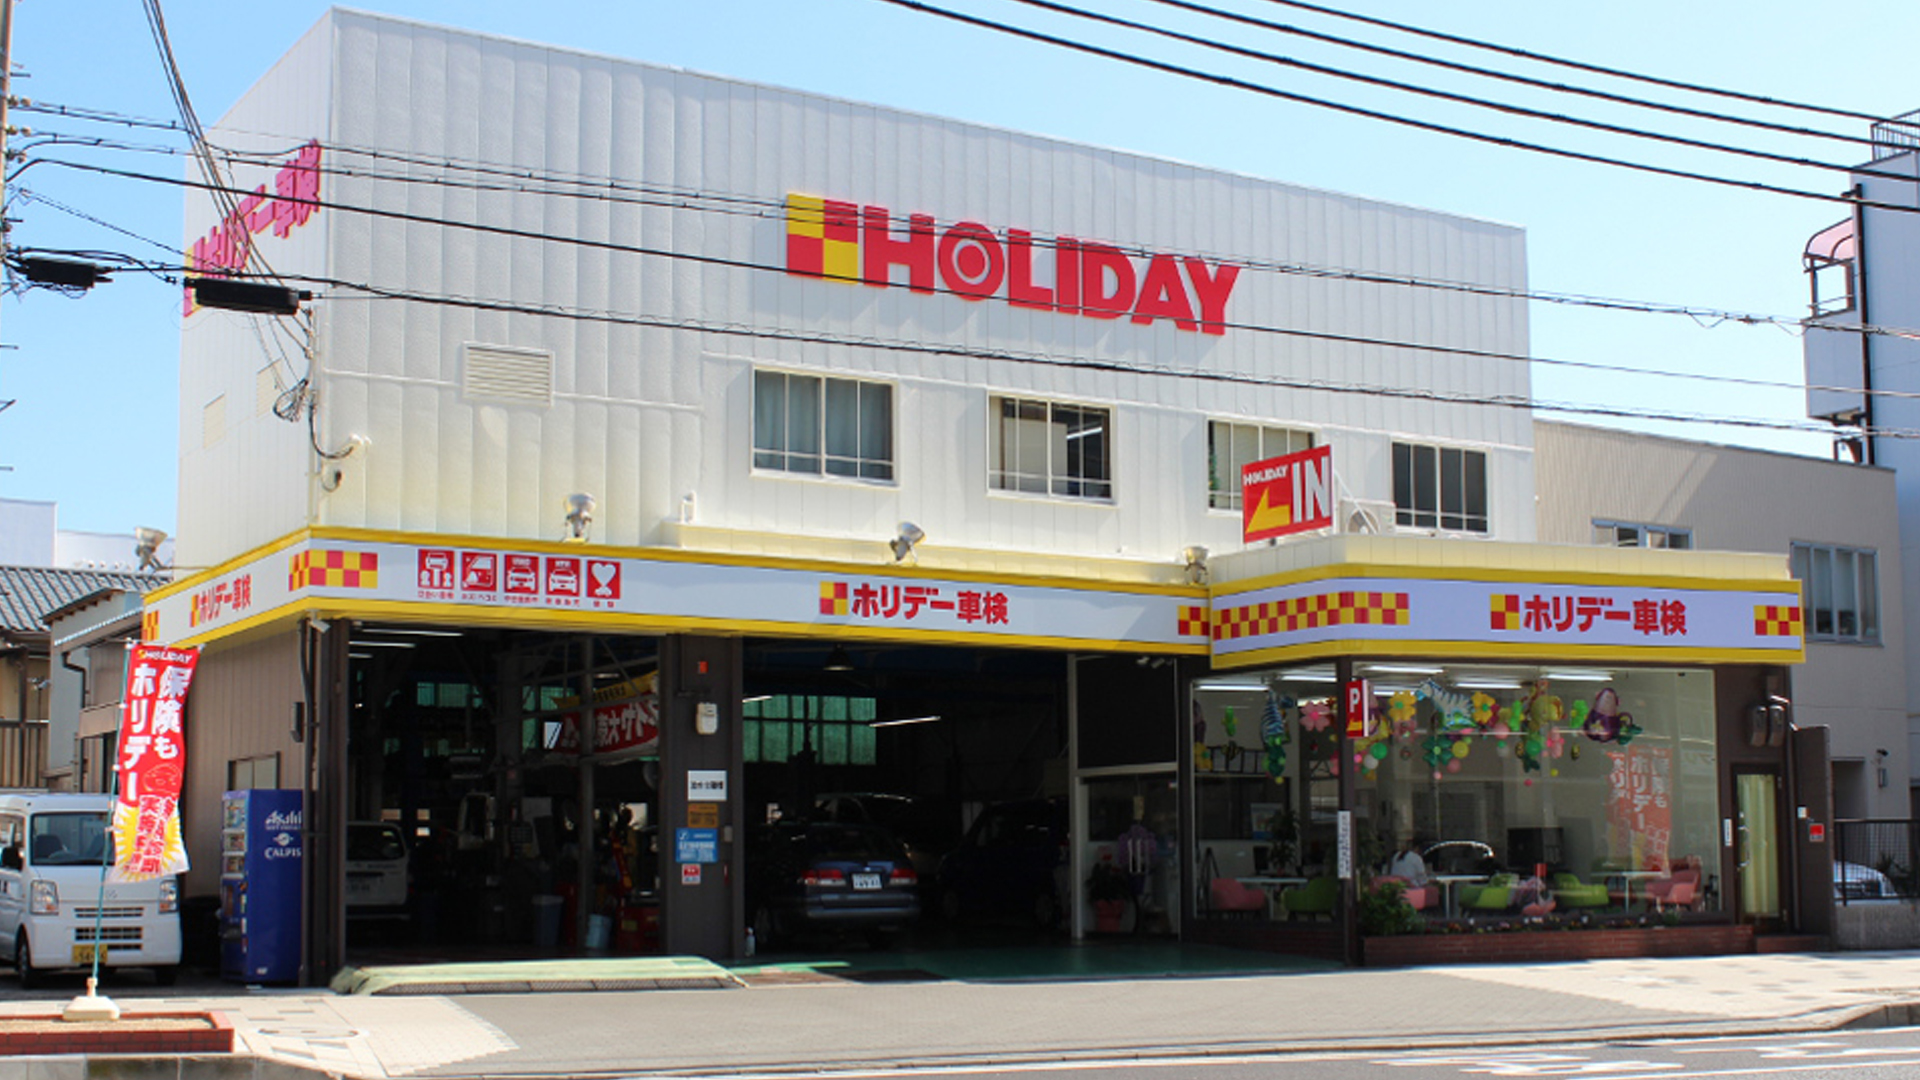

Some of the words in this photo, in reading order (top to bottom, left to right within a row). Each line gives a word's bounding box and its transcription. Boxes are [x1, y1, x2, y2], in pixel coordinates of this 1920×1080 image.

[863, 204, 1241, 336] HOLIDAY
[1243, 465, 1288, 486] HOLIDAY
[1293, 456, 1331, 524] IN
[199, 573, 252, 624] ホリデー車検
[851, 583, 1009, 625] ホリデー車検
[1523, 594, 1688, 636] ホリデー車検
[145, 650, 193, 664] HOLIDAY
[151, 664, 193, 760] 保険も
[1349, 687, 1361, 713] P
[123, 663, 158, 801] ホリデー
[265, 809, 302, 825] Asahi
[264, 847, 302, 859] CALPIS
